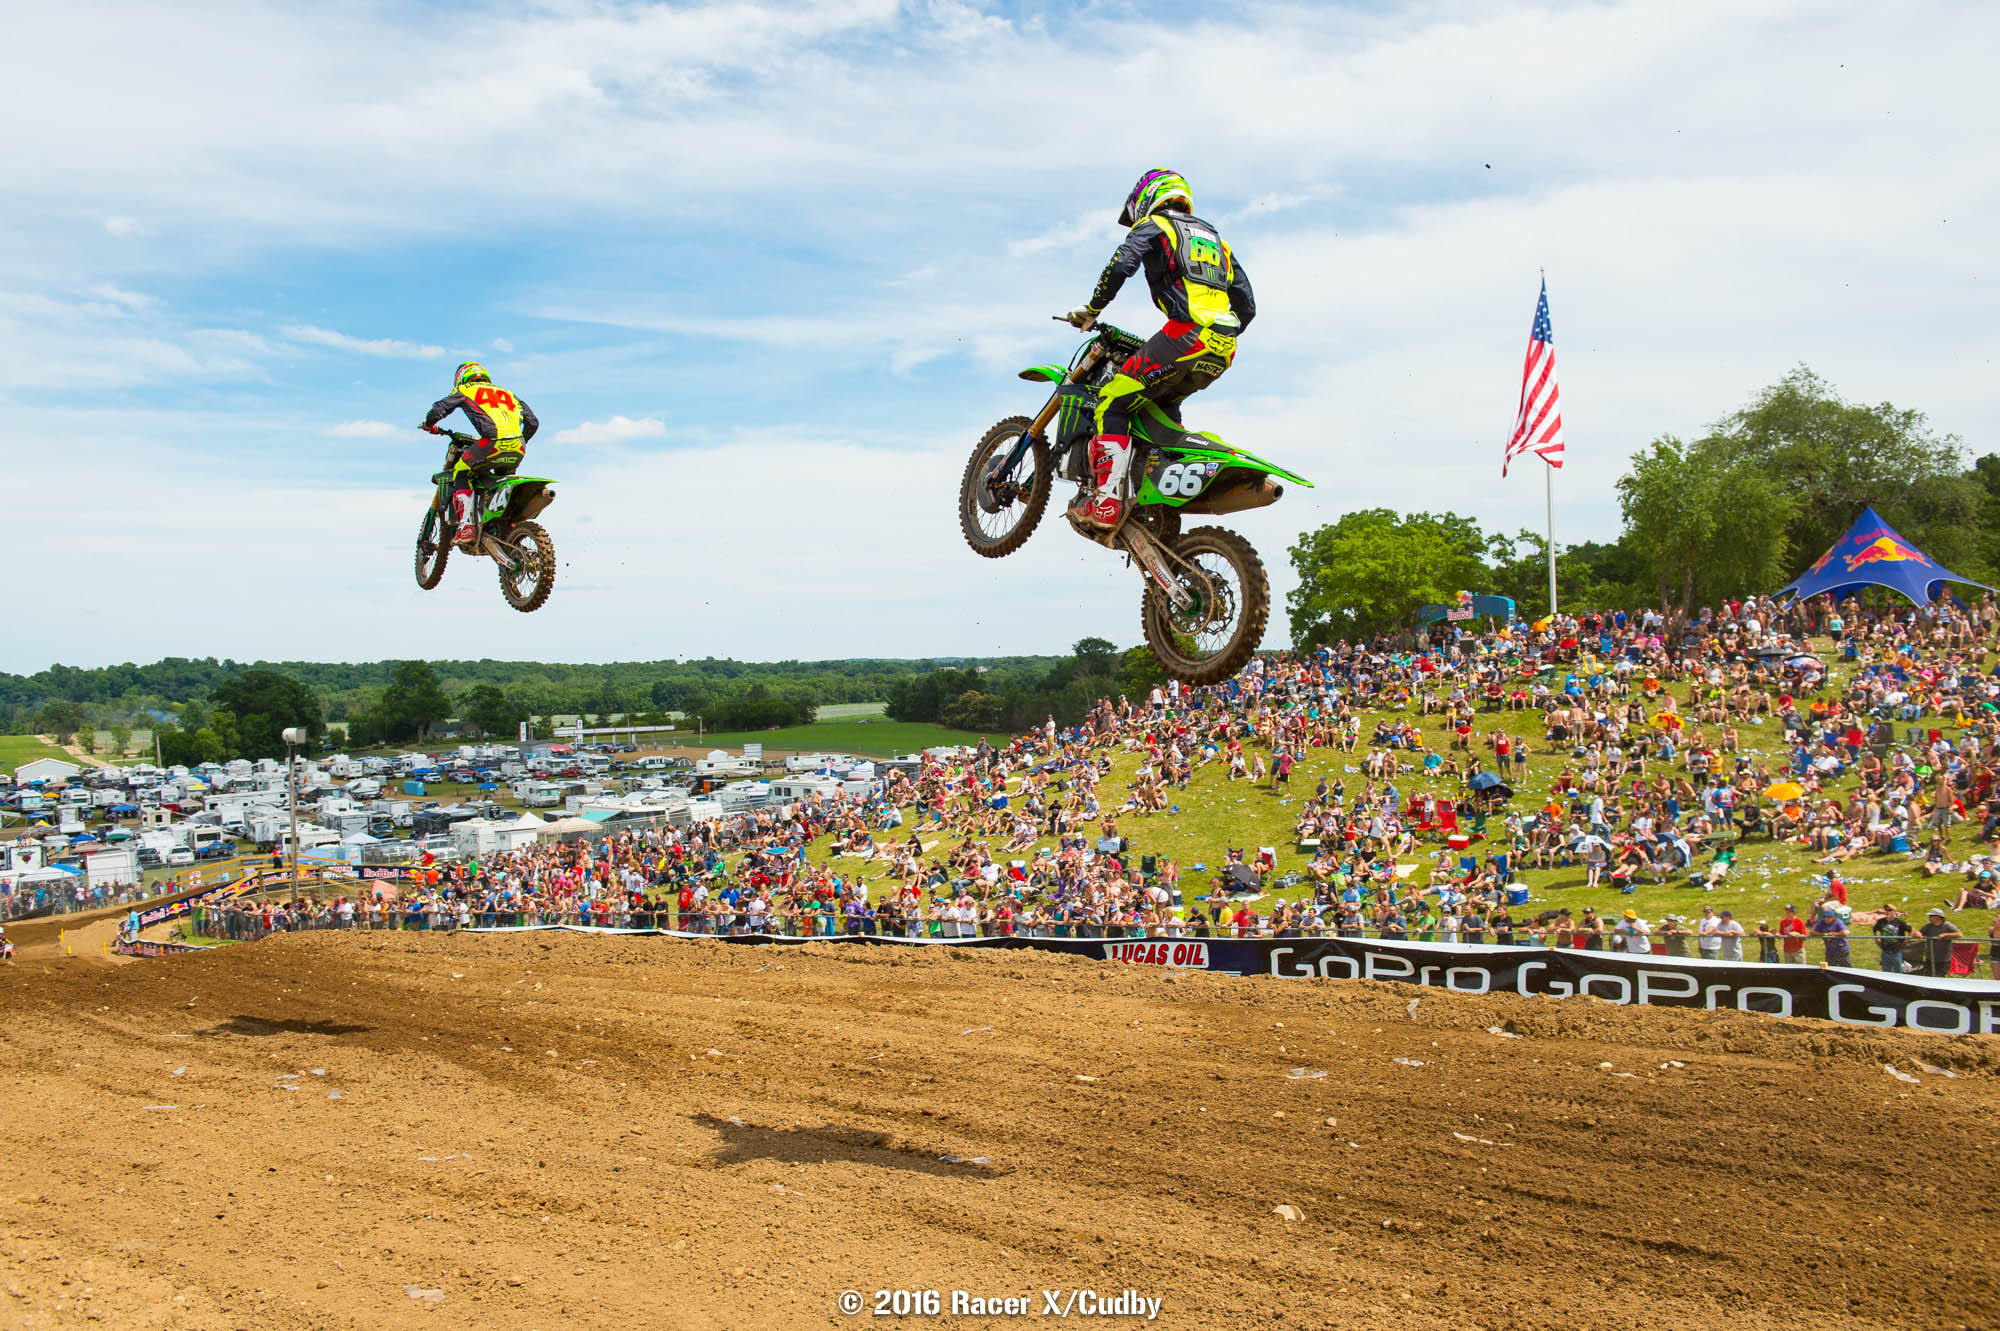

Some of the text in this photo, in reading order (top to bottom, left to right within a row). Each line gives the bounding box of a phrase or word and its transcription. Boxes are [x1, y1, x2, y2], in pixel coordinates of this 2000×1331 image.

[1190, 236, 1220, 266] 66
[474, 387, 516, 412] 44
[1158, 463, 1206, 496] 66
[488, 488, 509, 512] 44
[1112, 943, 1205, 965] LUCAS OIL
[1270, 947, 1491, 994] GoPro
[1516, 961, 1793, 1018] GoPro
